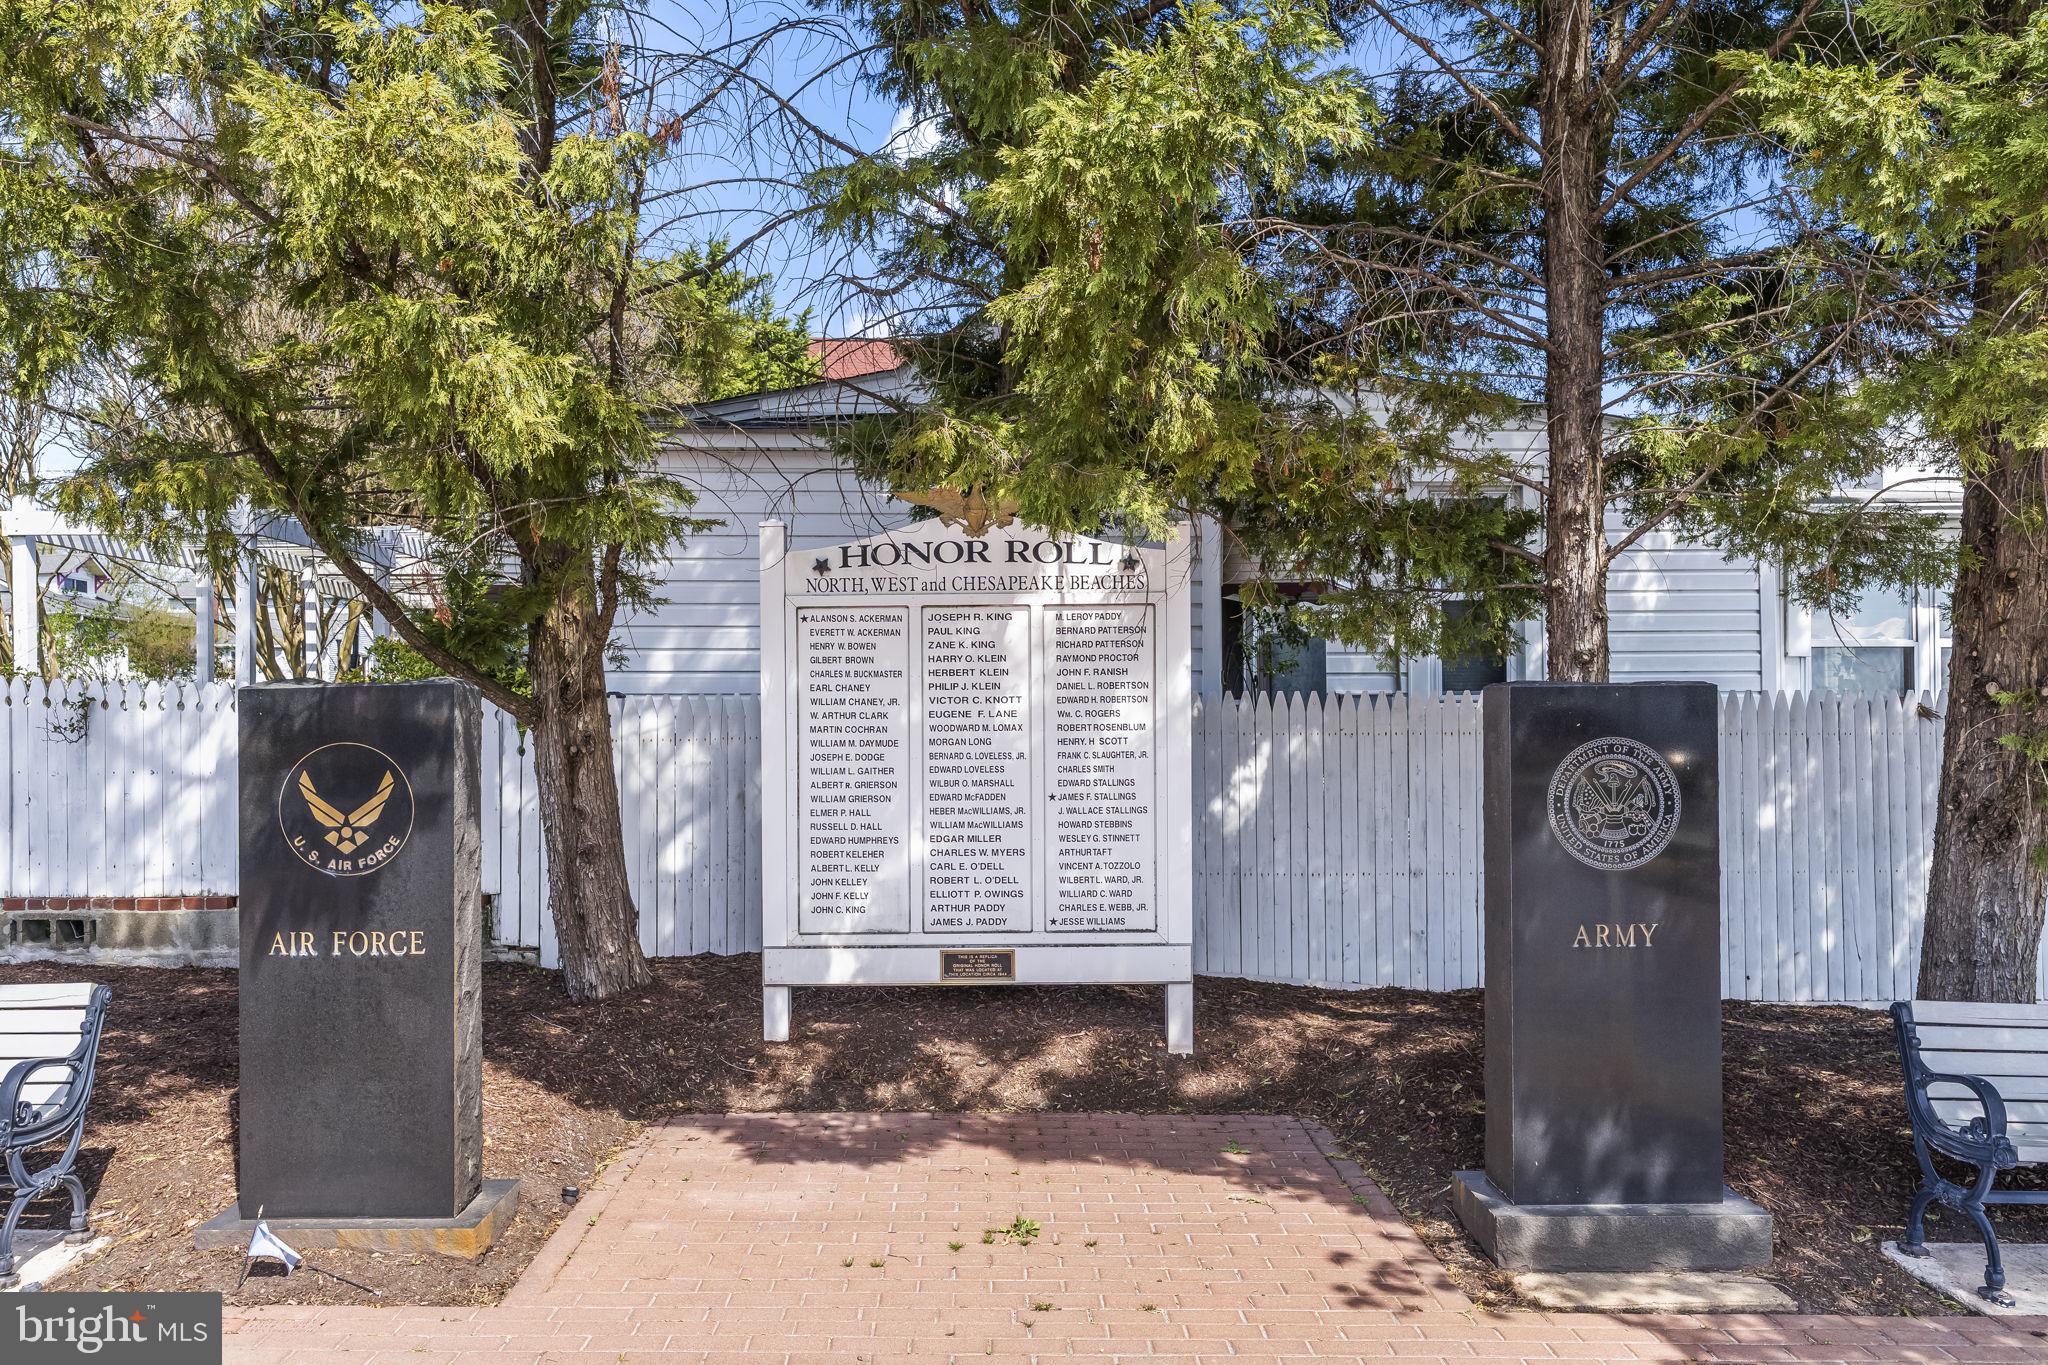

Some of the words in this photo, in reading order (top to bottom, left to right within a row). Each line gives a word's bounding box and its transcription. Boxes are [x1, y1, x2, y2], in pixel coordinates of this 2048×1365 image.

[838, 540, 991, 568] HONOR
[1004, 540, 1114, 565] ROLL
[806, 578, 868, 595] NORTH,
[872, 576, 918, 592] WEST
[921, 576, 946, 591] and
[952, 575, 1064, 591] CHESAPEAKE
[1071, 575, 1144, 590] BEACHES
[810, 614, 848, 623] ALANSON
[849, 614, 857, 623] S.
[858, 614, 902, 623] ACKERMAN
[928, 613, 971, 622] JOSEPH
[986, 612, 1012, 621] KING
[928, 627, 953, 635] PAUL
[956, 627, 980, 635] KING
[1056, 626, 1097, 635] BERNARD
[1097, 626, 1146, 634] PATTERSON
[810, 642, 835, 650] HENRY
[847, 642, 876, 650] BOWEN
[928, 641, 956, 649] ZANE
[971, 640, 996, 649] KING
[1056, 640, 1094, 649] RICHARD
[1095, 640, 1144, 648] PATTERSON
[810, 656, 842, 664] GILBERT
[845, 656, 874, 664] BROWN
[1056, 654, 1097, 662] RAYMOND
[1098, 654, 1139, 662] PROCTOR
[928, 668, 976, 677] HERBERT
[979, 668, 1009, 676] KLEIN
[1056, 668, 1082, 676] JOHN
[1083, 668, 1091, 676] F.
[1093, 668, 1128, 676] RANISH
[810, 684, 833, 692] EARL
[835, 684, 870, 692] CHANEY
[1056, 682, 1086, 690] DANIEL
[1088, 682, 1096, 690] L.
[1097, 681, 1149, 690] ROBERTSON
[929, 696, 969, 704] VICTOR
[972, 696, 982, 704] C.
[985, 696, 1022, 704] KNOTT
[1056, 696, 1090, 704] EDWARD
[1099, 695, 1148, 704] ROBERTSON
[821, 712, 857, 720] ARTHUR
[858, 712, 888, 720] CLARK
[844, 725, 888, 734] COCHRAN
[1057, 724, 1092, 732] ROBERT
[1093, 723, 1146, 732] ROSENBLUM
[929, 738, 967, 746] MORGAN
[968, 738, 992, 746] LONG
[810, 767, 846, 775] WILLIAM
[929, 766, 963, 774] EDWARD
[964, 765, 1005, 774] LOVELESS
[1057, 765, 1092, 773] CHARLES
[1092, 765, 1115, 773] SMITH
[1556, 745, 1609, 796] DEPARTMENT
[1614, 745, 1629, 753] OF
[1633, 748, 1655, 765] THE
[1653, 764, 1673, 795] ARMY
[1057, 779, 1091, 787] EDWARD
[1092, 778, 1135, 787] STALLINGS
[848, 794, 891, 803] GRIERSON
[929, 793, 963, 802] EDWARD
[1058, 793, 1084, 801] JAMES
[1086, 792, 1092, 801] F.
[1094, 792, 1136, 801] STALLINGS
[929, 807, 956, 815] HEBER
[1058, 807, 1064, 815] J.
[1066, 806, 1104, 815] WALLACE
[1106, 806, 1148, 814] STALLINGS
[810, 822, 848, 831] RUSSELL
[850, 822, 858, 831] D.
[860, 822, 882, 831] HALL
[1058, 820, 1092, 829] HOWARD
[1094, 820, 1133, 828] STEBBINS
[810, 836, 846, 845] EDWARD
[848, 836, 899, 845] HUMPHREYS
[930, 834, 964, 843] EDGAR
[967, 834, 1002, 843] MILLER
[1556, 813, 1583, 850] UNITED
[1584, 849, 1619, 862] STATES
[1624, 851, 1638, 862] OF
[1642, 814, 1673, 855] AMERICA
[327, 858, 352, 871] AIR
[358, 835, 401, 869] FORCE
[810, 850, 845, 858] ROBERT
[845, 850, 885, 858] KELEHER
[930, 848, 976, 857] CHARLES
[978, 848, 989, 856] W.
[991, 848, 1026, 856] MYERS
[1058, 848, 1092, 856] ARTHUR
[1092, 848, 1112, 856] TAFT
[810, 878, 833, 886] JOHN
[834, 878, 868, 886] KELLEY
[930, 876, 970, 884] ROBERT
[974, 876, 982, 885] L.
[984, 876, 1019, 884] O'DELL
[930, 890, 970, 898] ELLIOTT
[984, 890, 1024, 898] OWINGS
[1099, 889, 1108, 898] C.
[1108, 889, 1133, 898] WARD
[811, 906, 834, 914] JOHN
[835, 906, 844, 914] C.
[845, 906, 866, 914] KING
[930, 904, 970, 912] ARTHUR
[974, 904, 1006, 912] PADDY
[1059, 917, 1084, 926] JESSE
[1086, 917, 1126, 926] WILLIAMS
[1572, 924, 1658, 948] ARMY
[269, 931, 318, 956] AIR
[331, 931, 426, 956] FORCE
